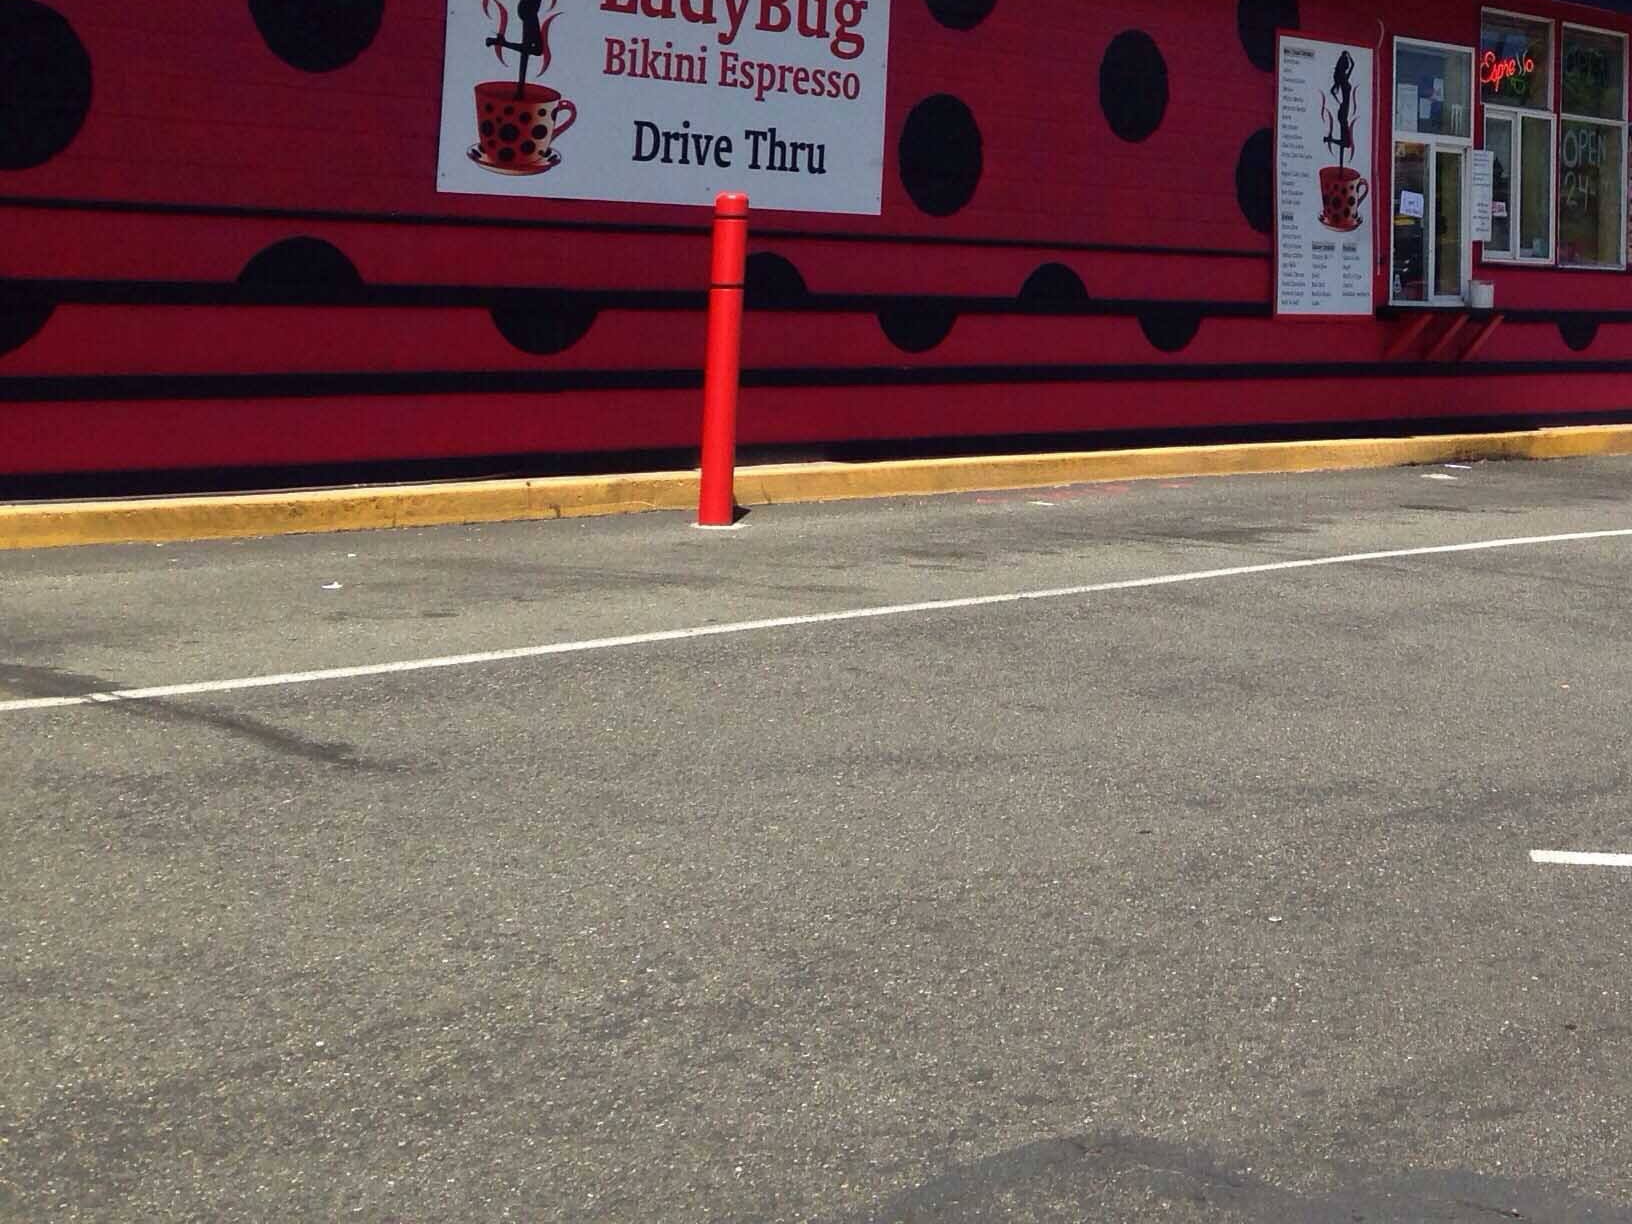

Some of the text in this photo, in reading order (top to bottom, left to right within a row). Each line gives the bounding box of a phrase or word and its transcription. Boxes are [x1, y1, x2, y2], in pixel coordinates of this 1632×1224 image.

[602, 38, 861, 102] Bikini Espresso
[632, 120, 827, 174] Drive Thru
